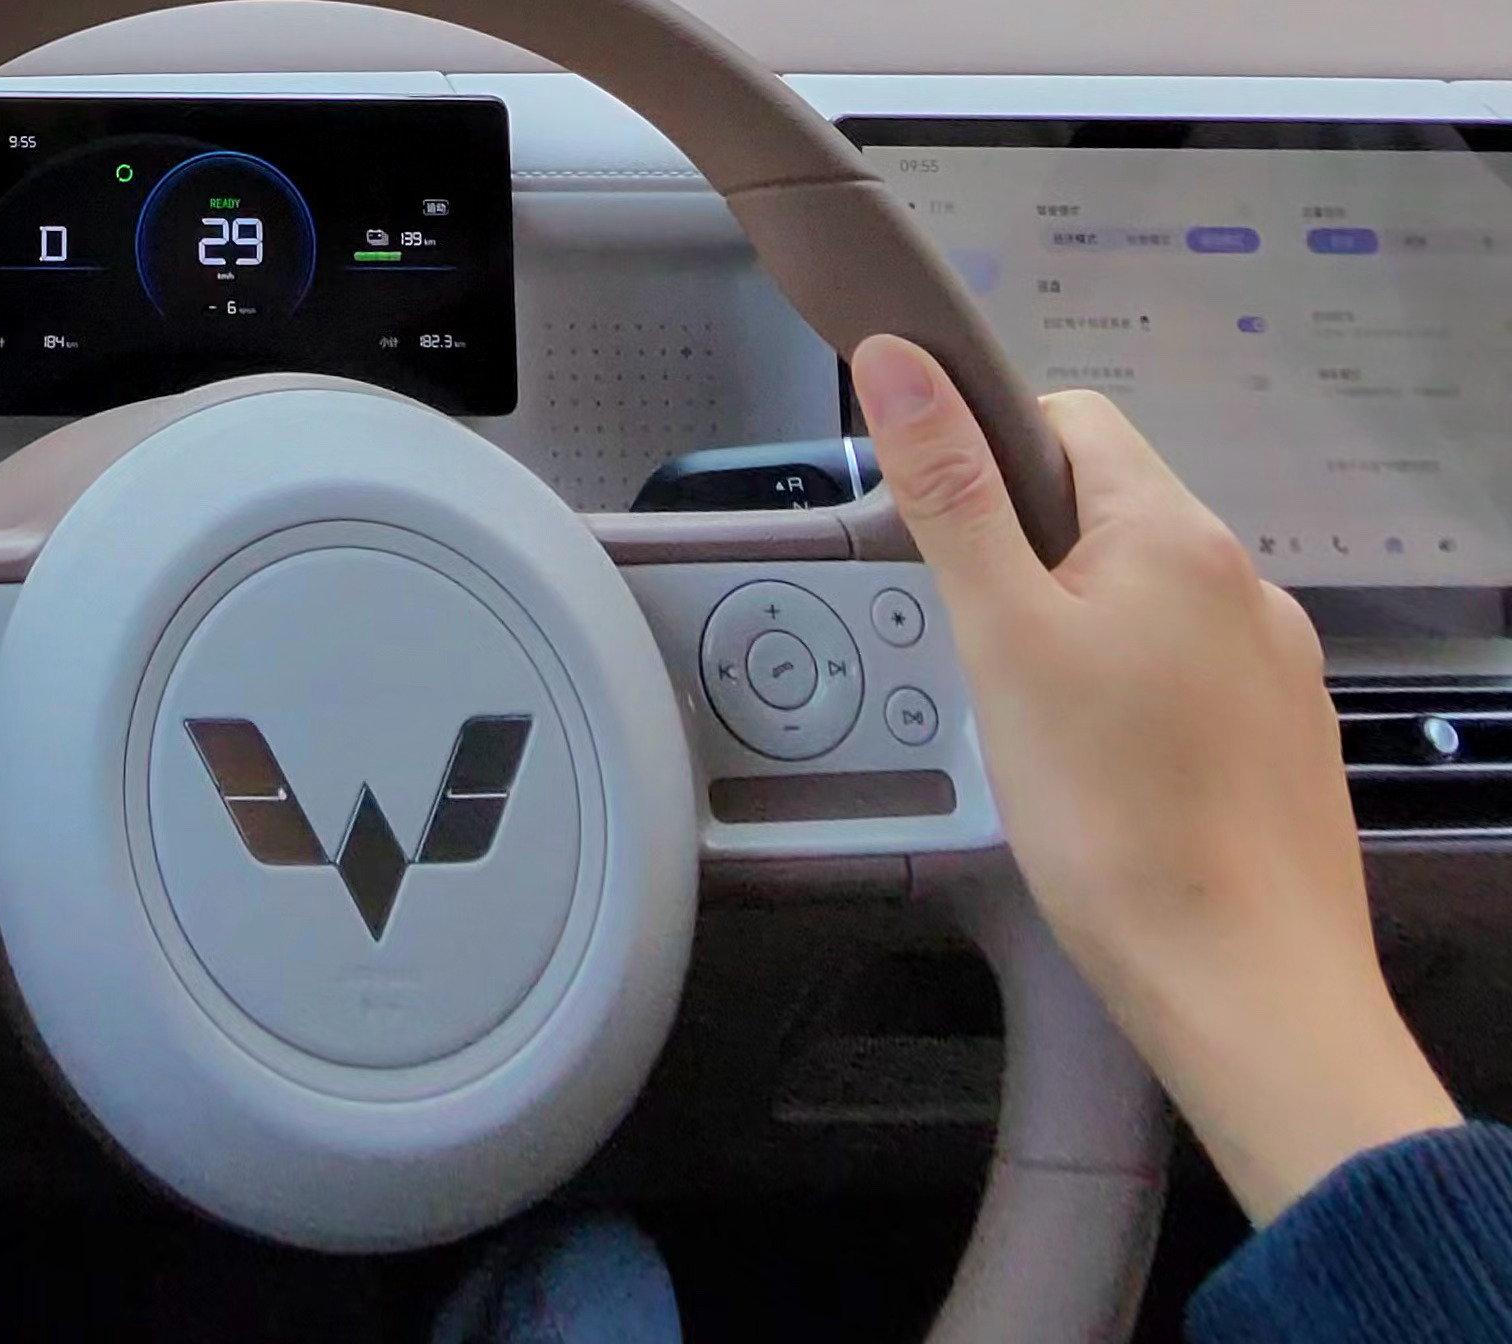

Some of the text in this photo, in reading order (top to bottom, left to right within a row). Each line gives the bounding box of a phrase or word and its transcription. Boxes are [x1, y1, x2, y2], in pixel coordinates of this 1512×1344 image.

[9, 135, 37, 148] 9:55
[899, 159, 940, 173] 09:55
[209, 198, 241, 209] READY
[198, 217, 263, 265] 29
[400, 232, 423, 246] 139
[44, 335, 65, 349] 184
[419, 334, 453, 348] 182.3
[787, 476, 804, 492] R
